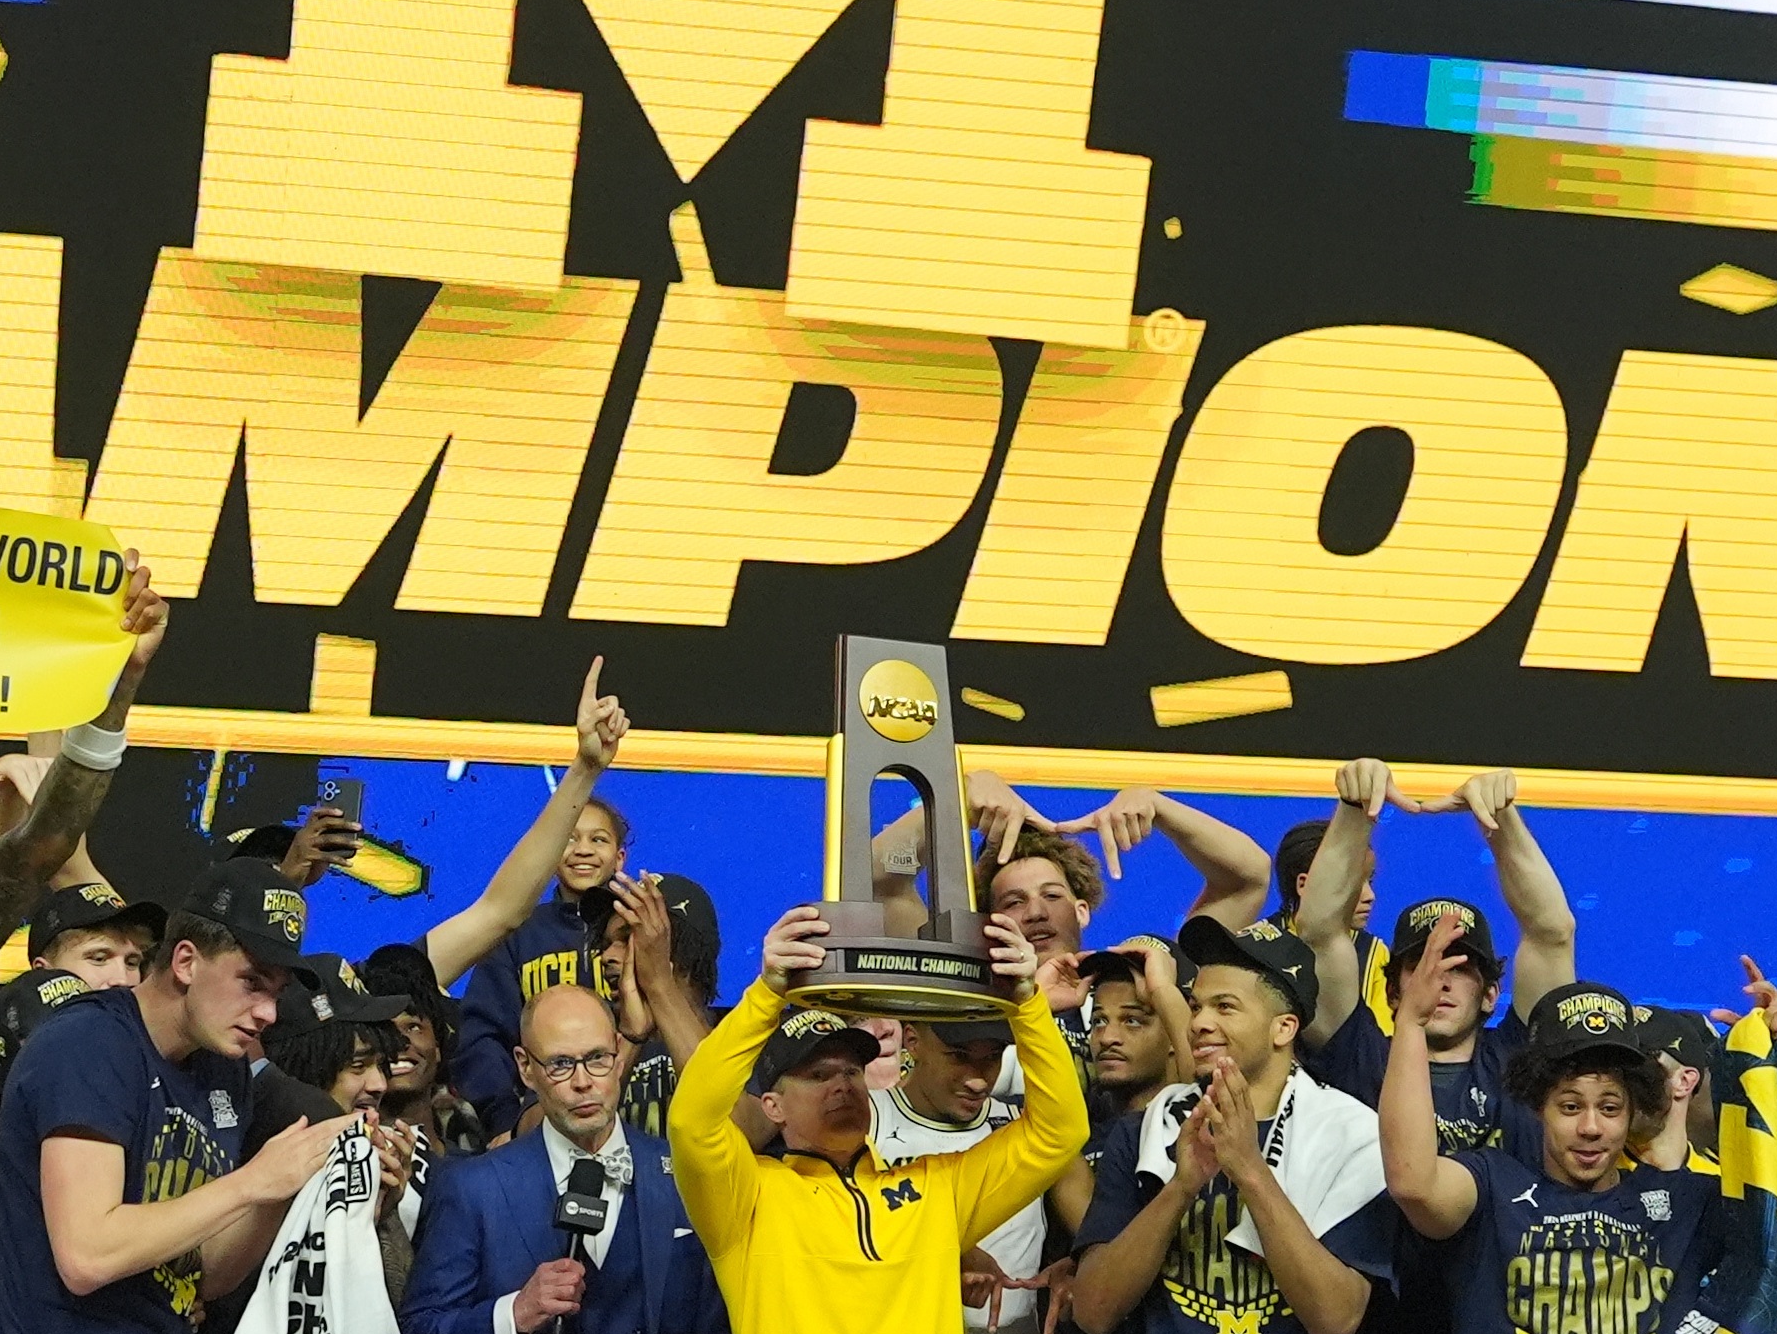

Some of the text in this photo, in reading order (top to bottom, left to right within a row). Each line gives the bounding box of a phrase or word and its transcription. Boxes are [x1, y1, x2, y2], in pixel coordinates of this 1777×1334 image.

[0, 675, 11, 713] !
[857, 953, 981, 980] NATIONAL CHAMPION
[1558, 993, 1627, 1025] CHAMPIONS
[1588, 1016, 1606, 1028] M
[881, 1178, 922, 1211] M
[579, 1207, 605, 1218] SPORTS
